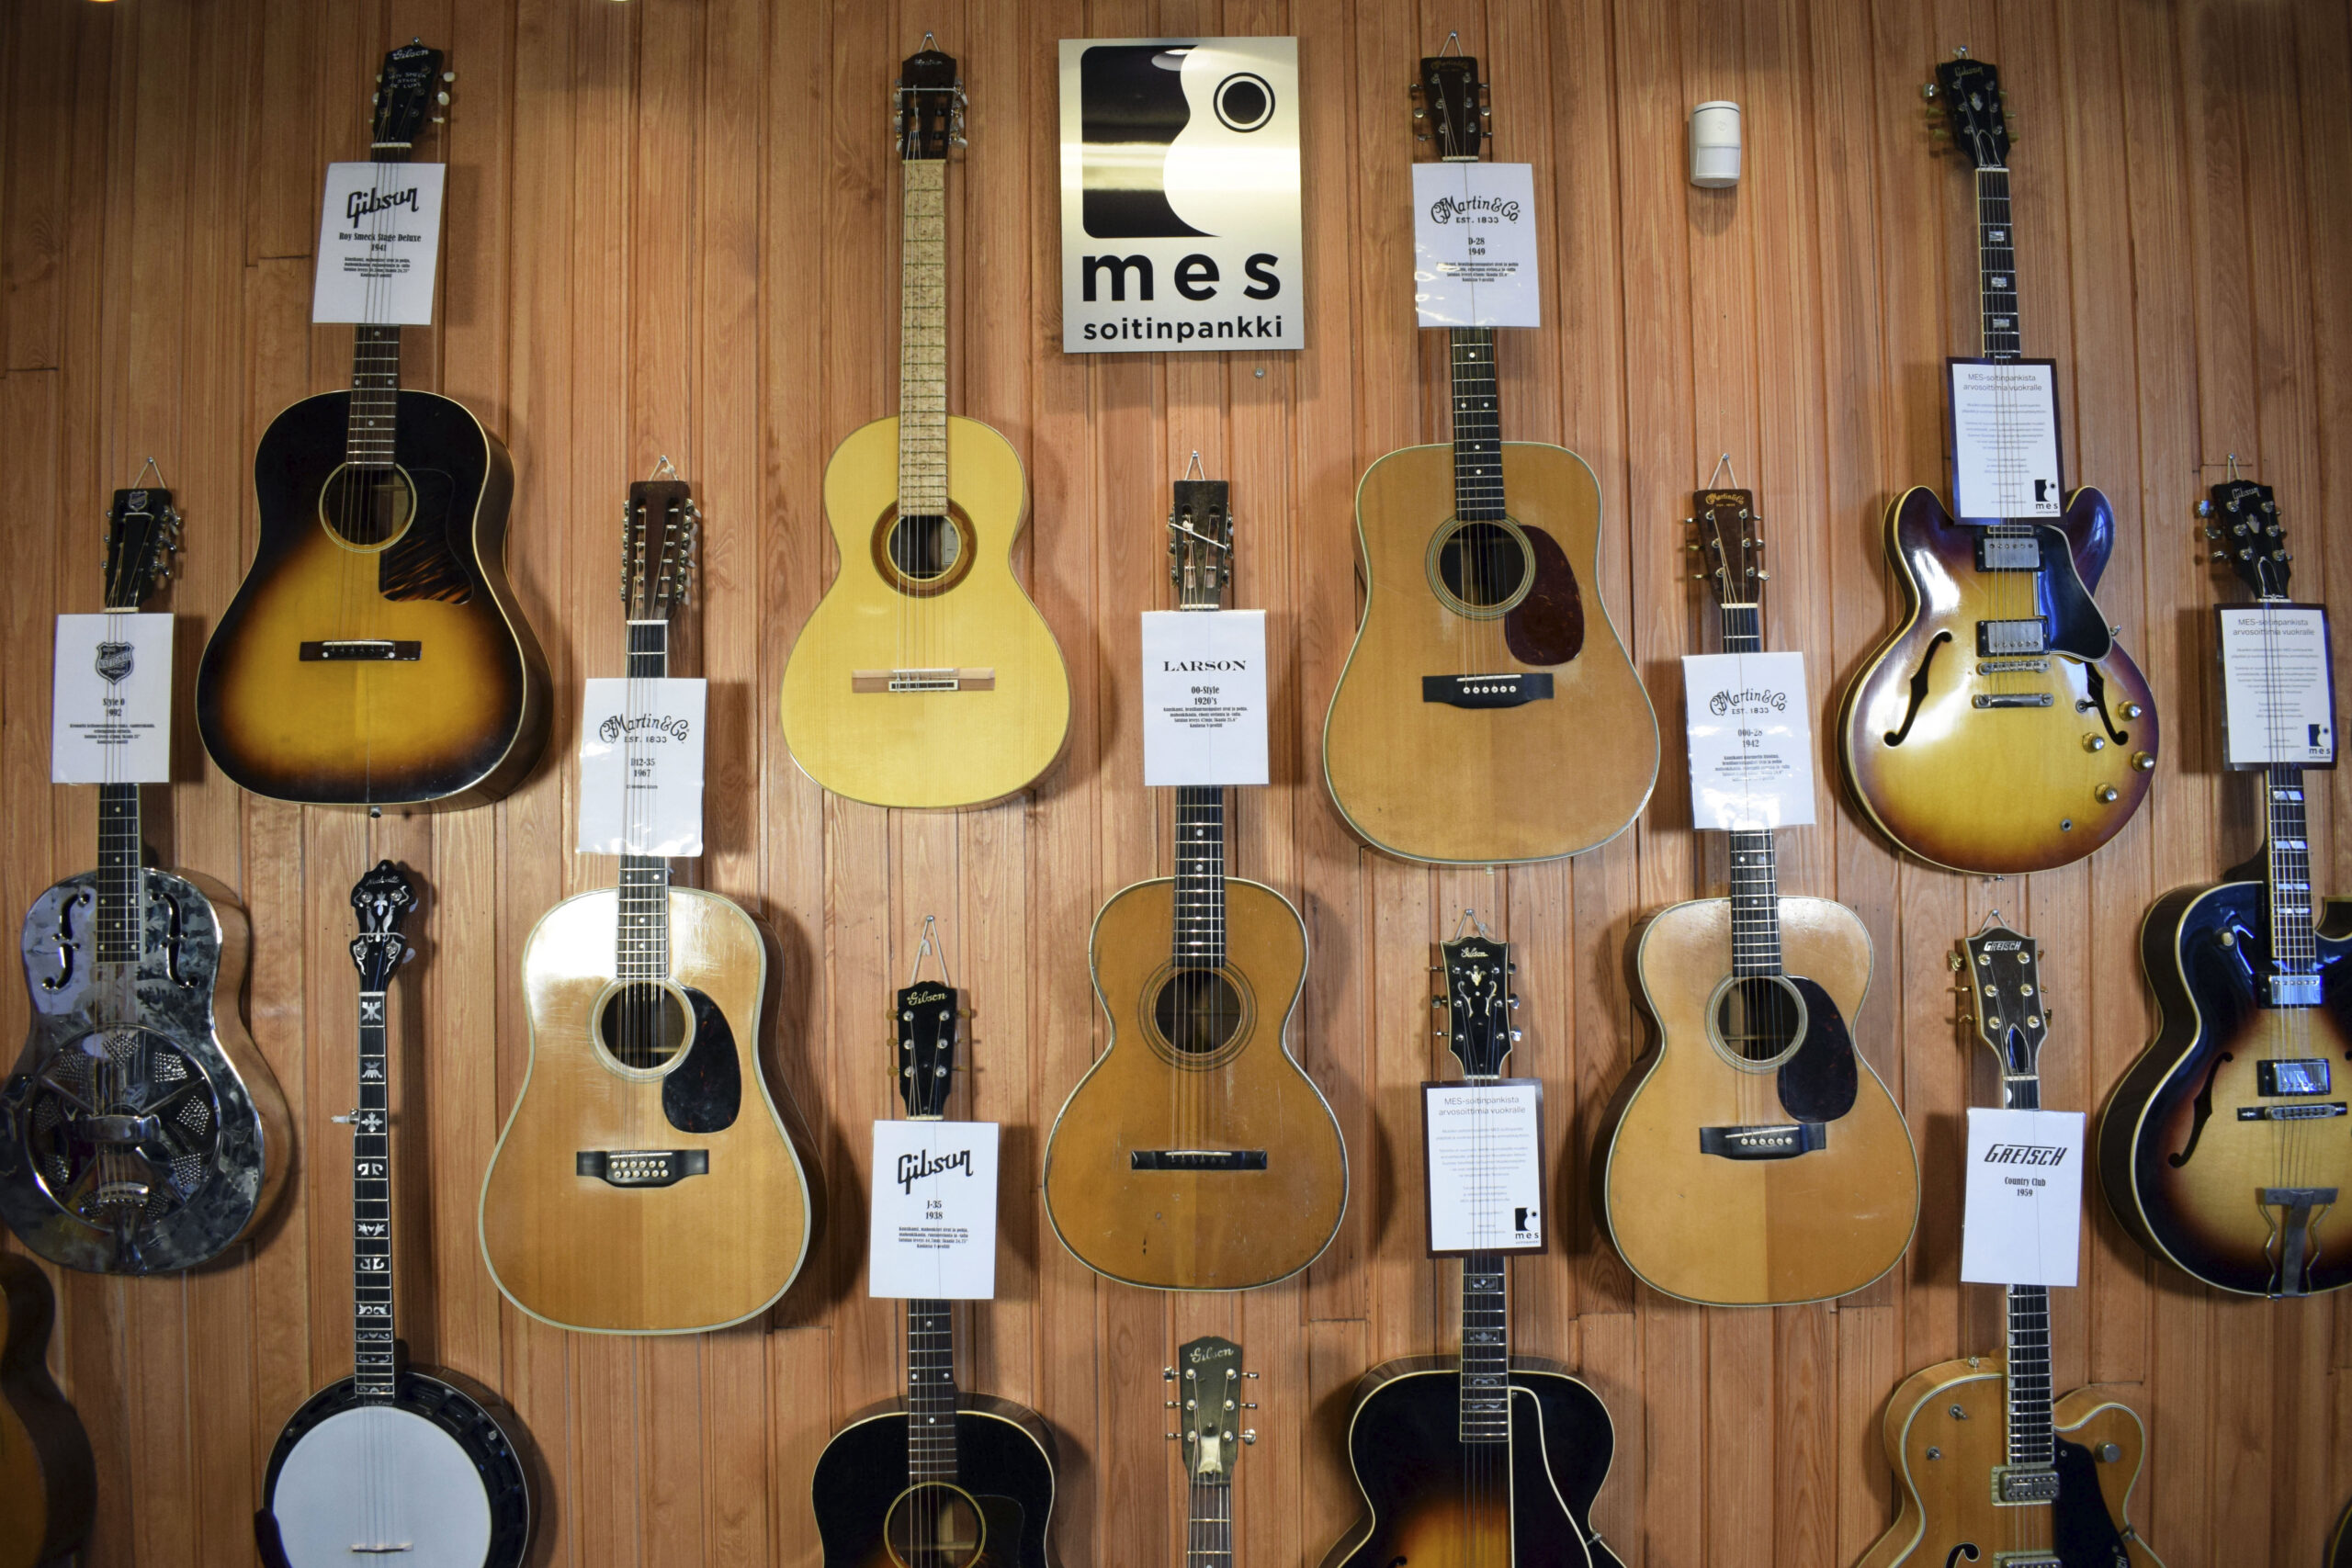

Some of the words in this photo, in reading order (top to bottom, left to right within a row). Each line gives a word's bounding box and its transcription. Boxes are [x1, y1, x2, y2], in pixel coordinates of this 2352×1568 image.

[392, 49, 429, 61] Gibson
[346, 187, 419, 229] Gibson
[339, 232, 352, 241] Roy
[354, 232, 375, 241] Smeck
[378, 233, 396, 243] Stage
[1468, 237, 1485, 245] D-28
[1468, 247, 1486, 255] 1949
[1082, 253, 1281, 301] mes
[1083, 315, 1282, 344] soitinpankki
[1163, 660, 1247, 671] LARSON
[103, 697, 119, 706] Style
[1194, 696, 1217, 705] 1920's
[1743, 739, 1759, 748] 1942
[630, 758, 655, 766] D12-35
[634, 769, 650, 777] 1967
[1984, 941, 2021, 952] GRETSCH
[907, 991, 947, 1006] Gibson
[1444, 1096, 1519, 1105] MES-soitinpankista
[1490, 1106, 1525, 1114] vuokralle
[1984, 1144, 2067, 1167] GRETSCH
[897, 1148, 974, 1195] Gibson
[2005, 1177, 2030, 1187] Country
[2031, 1177, 2046, 1187] Club
[2017, 1189, 2032, 1197] 1959
[927, 1201, 942, 1209] J-35
[925, 1212, 943, 1220] 1938
[1190, 1346, 1234, 1363] Gibson
